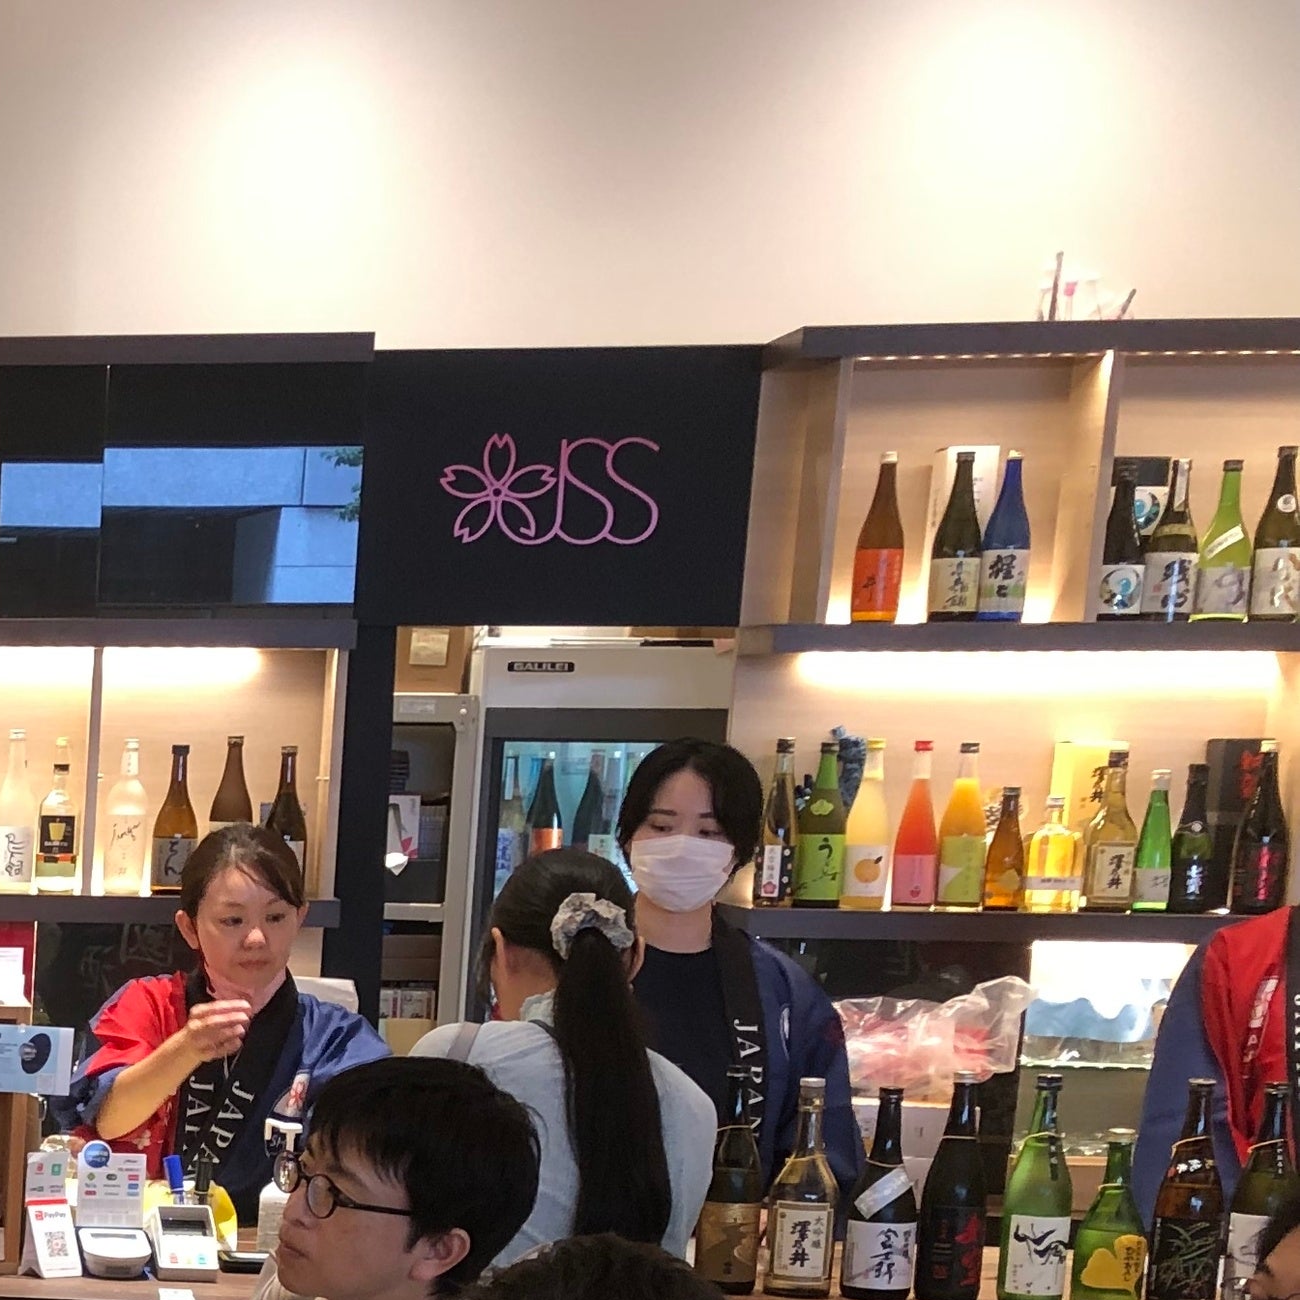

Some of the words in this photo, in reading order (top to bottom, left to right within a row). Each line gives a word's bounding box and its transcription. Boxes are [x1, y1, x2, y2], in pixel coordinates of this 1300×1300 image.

[512, 661, 570, 673] GALILEI
[788, 1219, 812, 1268] 澤乃井
